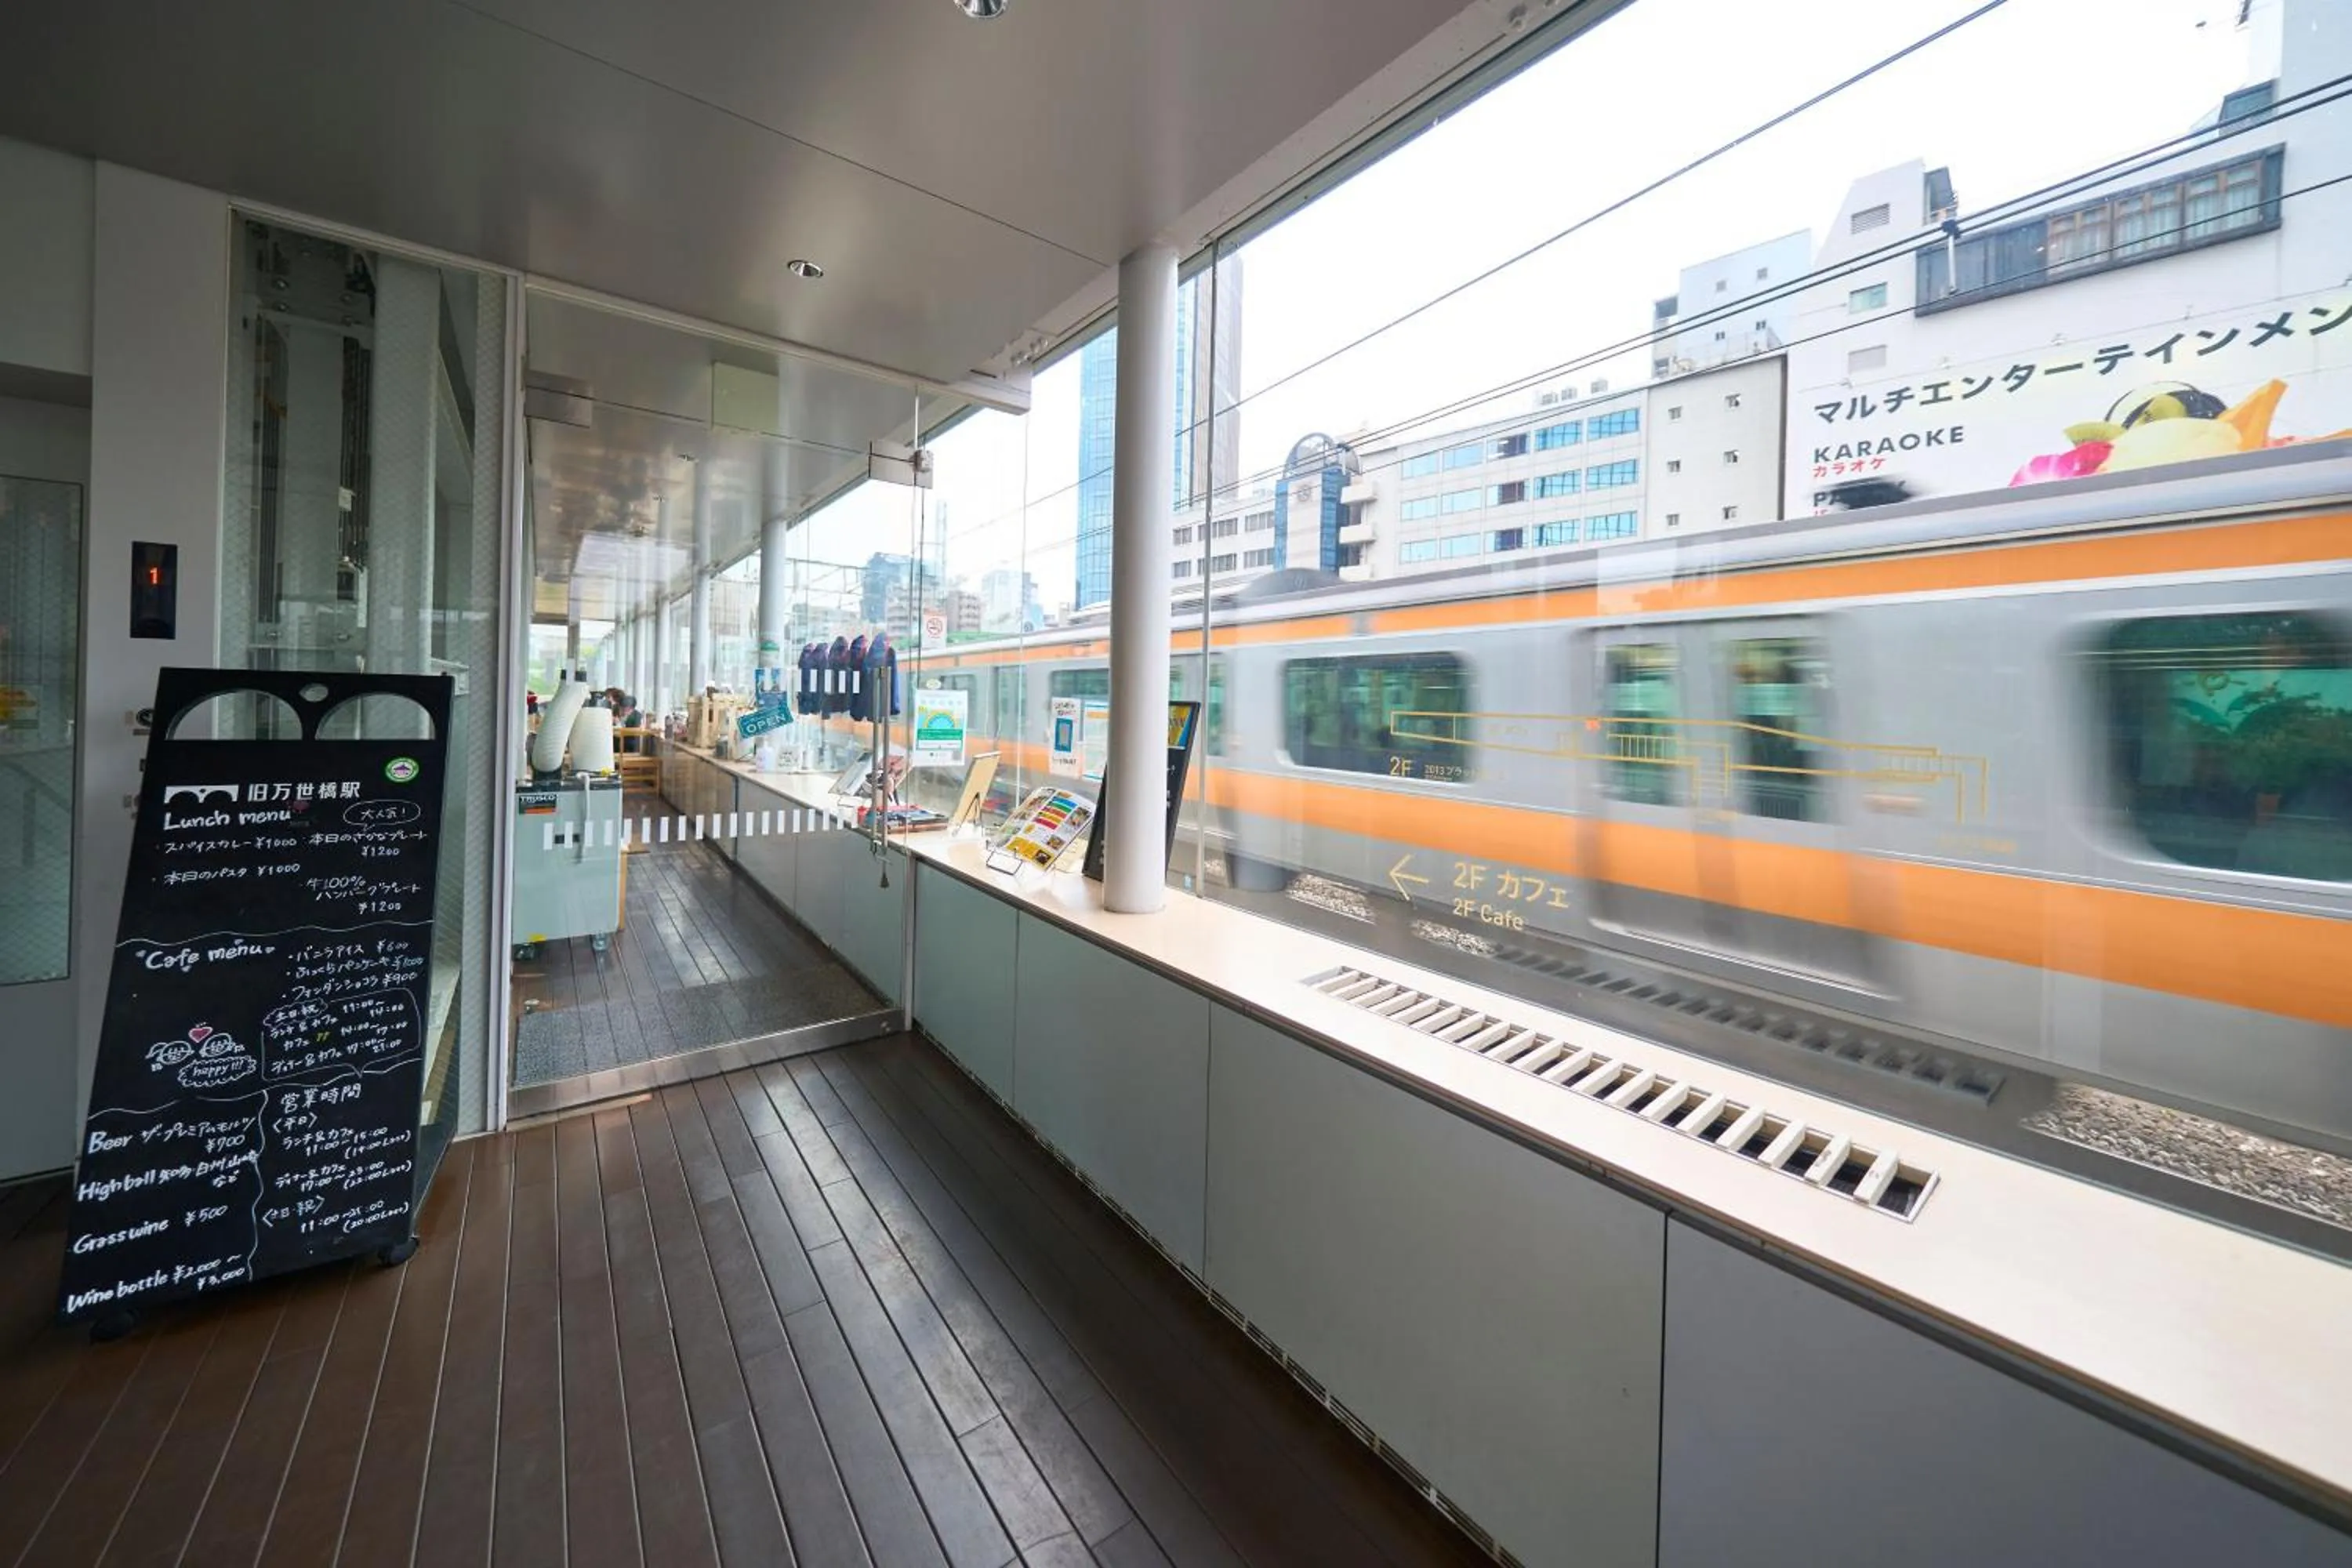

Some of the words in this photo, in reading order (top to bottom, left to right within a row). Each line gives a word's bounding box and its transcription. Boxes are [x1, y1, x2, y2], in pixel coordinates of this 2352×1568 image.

[1814, 426, 1964, 463] KARAOKE
[1813, 457, 1887, 477] カラオケ
[150, 567, 158, 584] 1
[746, 713, 786, 733] OPEN
[1389, 756, 1413, 777] 2F
[248, 782, 361, 801] 旧万世橋駅
[163, 810, 230, 830] Lunch
[238, 810, 291, 825] menu
[164, 868, 247, 884] 本日のパスタ
[1454, 862, 1487, 890] 2F
[1497, 870, 1571, 909] カフェ
[1454, 898, 1476, 916] 2F
[1479, 904, 1524, 931] Cafe
[146, 949, 200, 969] Cafe
[208, 945, 263, 961] menu
[281, 1083, 361, 1113] 営業時間
[88, 1131, 133, 1154] Beer
[67, 1288, 114, 1313] Wine
[117, 1269, 169, 1298] bottle
